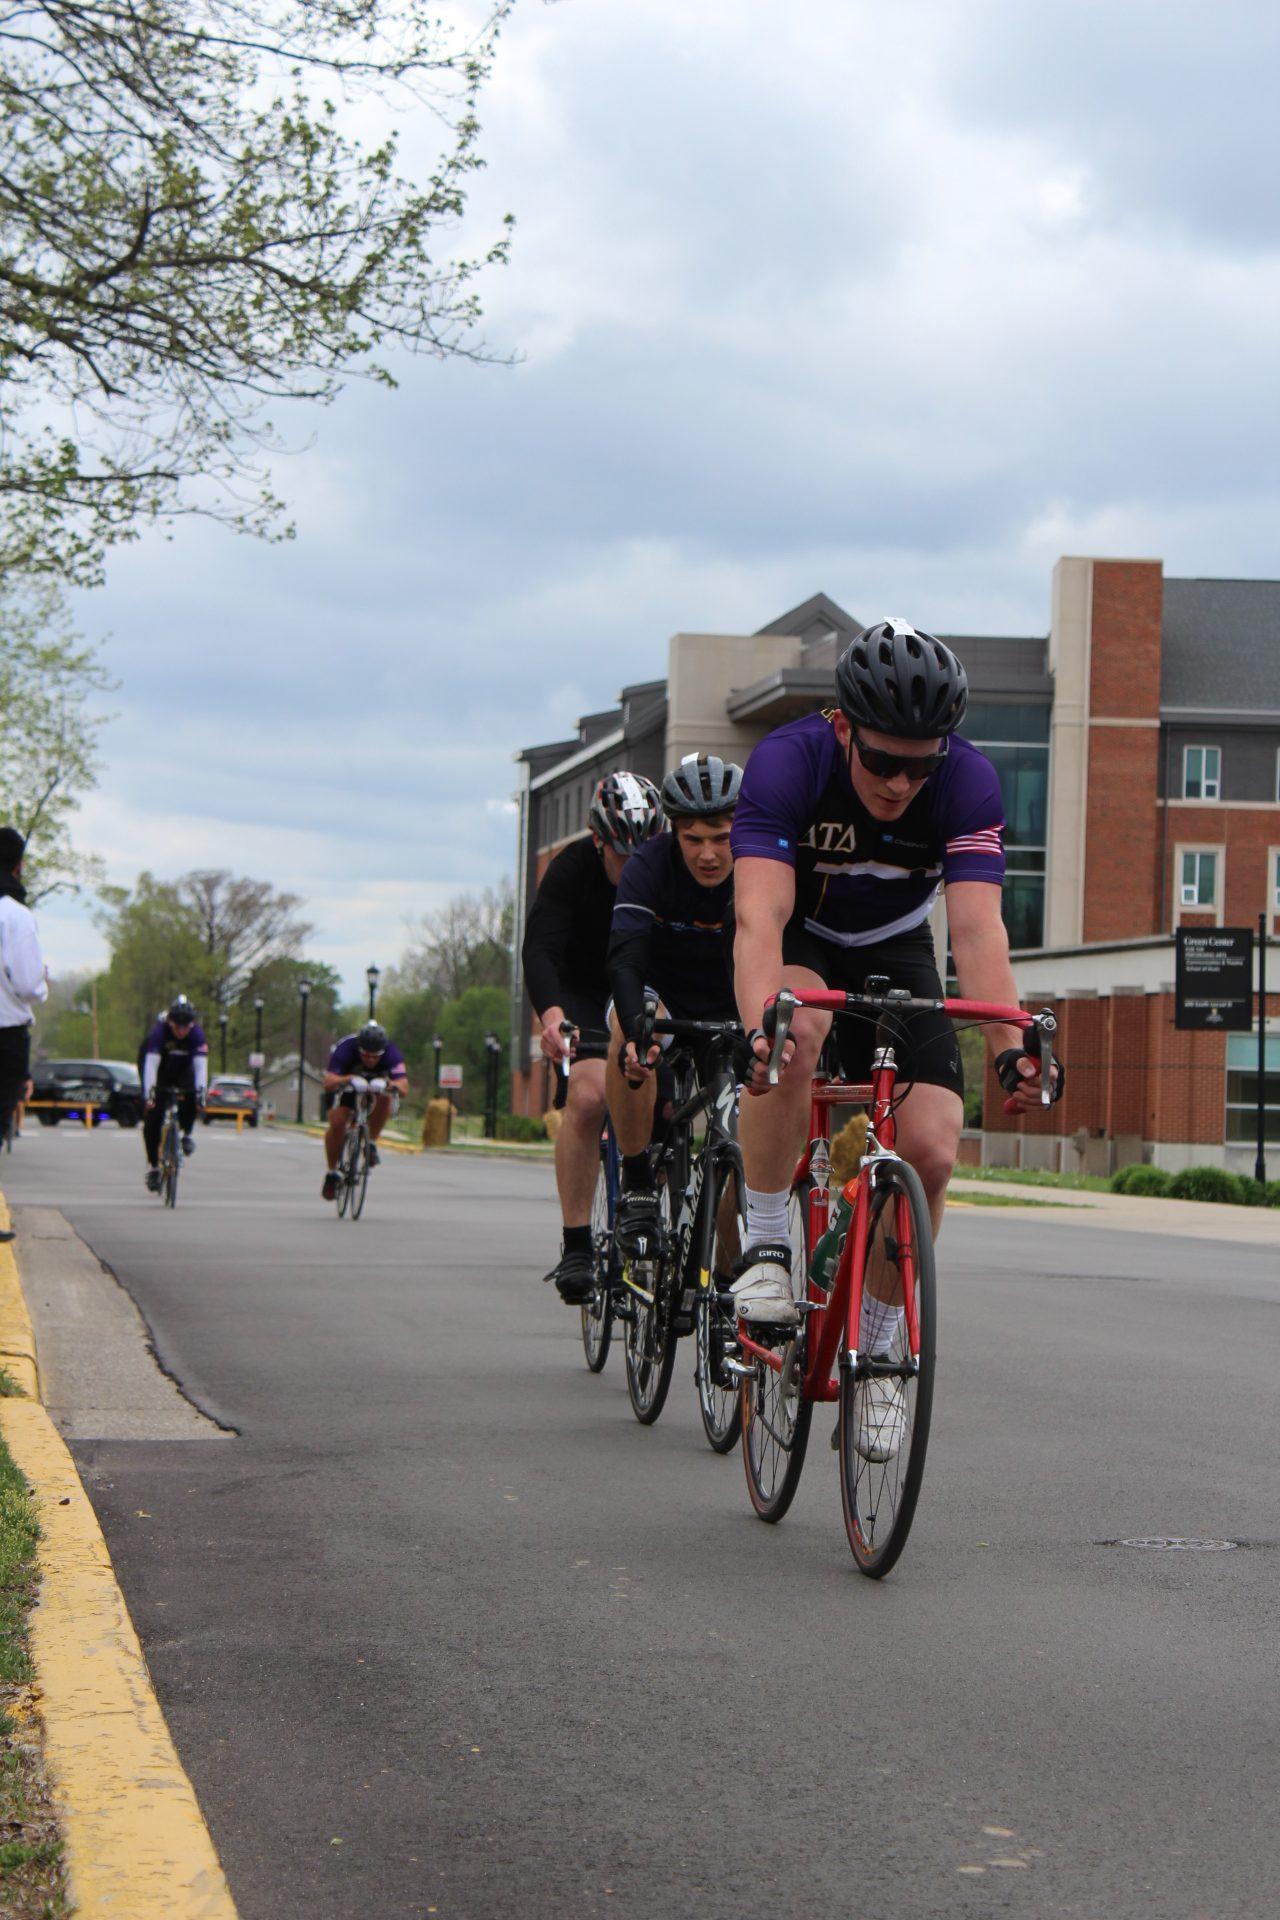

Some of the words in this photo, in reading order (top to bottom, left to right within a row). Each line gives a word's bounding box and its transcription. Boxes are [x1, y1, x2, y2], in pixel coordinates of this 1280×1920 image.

[1184, 936, 1208, 946] Green
[1209, 936, 1234, 946] Center
[758, 1250, 785, 1259] GIRO
